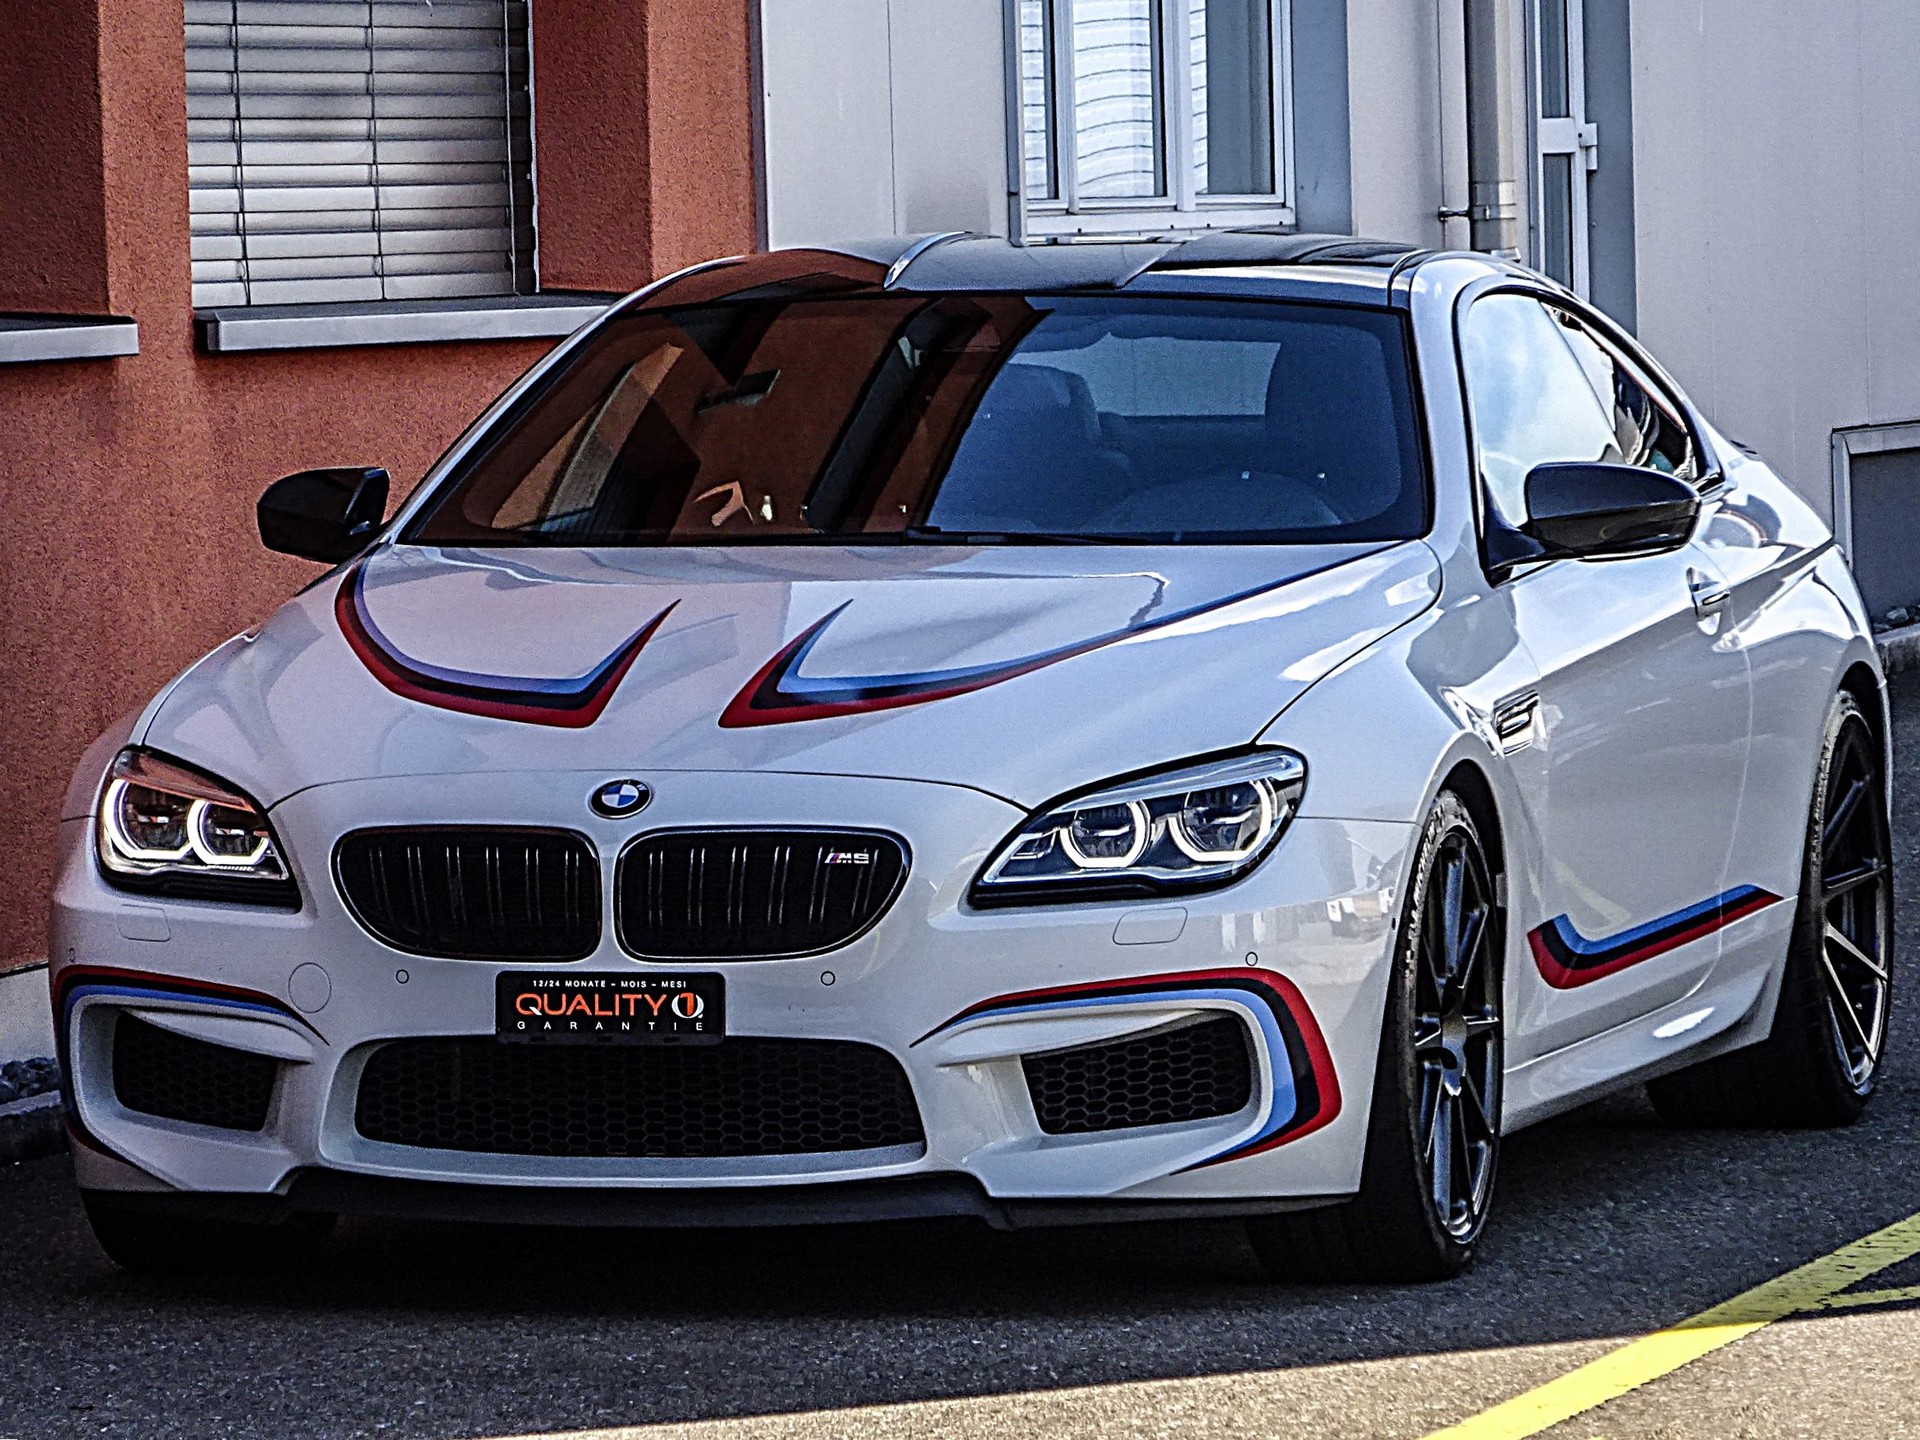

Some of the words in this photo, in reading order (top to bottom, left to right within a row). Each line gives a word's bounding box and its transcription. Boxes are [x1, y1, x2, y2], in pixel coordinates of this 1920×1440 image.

[532, 980, 560, 988] 12/24
[565, 980, 606, 988] MONATE
[620, 980, 647, 988] MOIS
[661, 980, 687, 988] MESI
[515, 993, 667, 1016] QUALITY
[517, 1020, 703, 1031] GARANTIE
